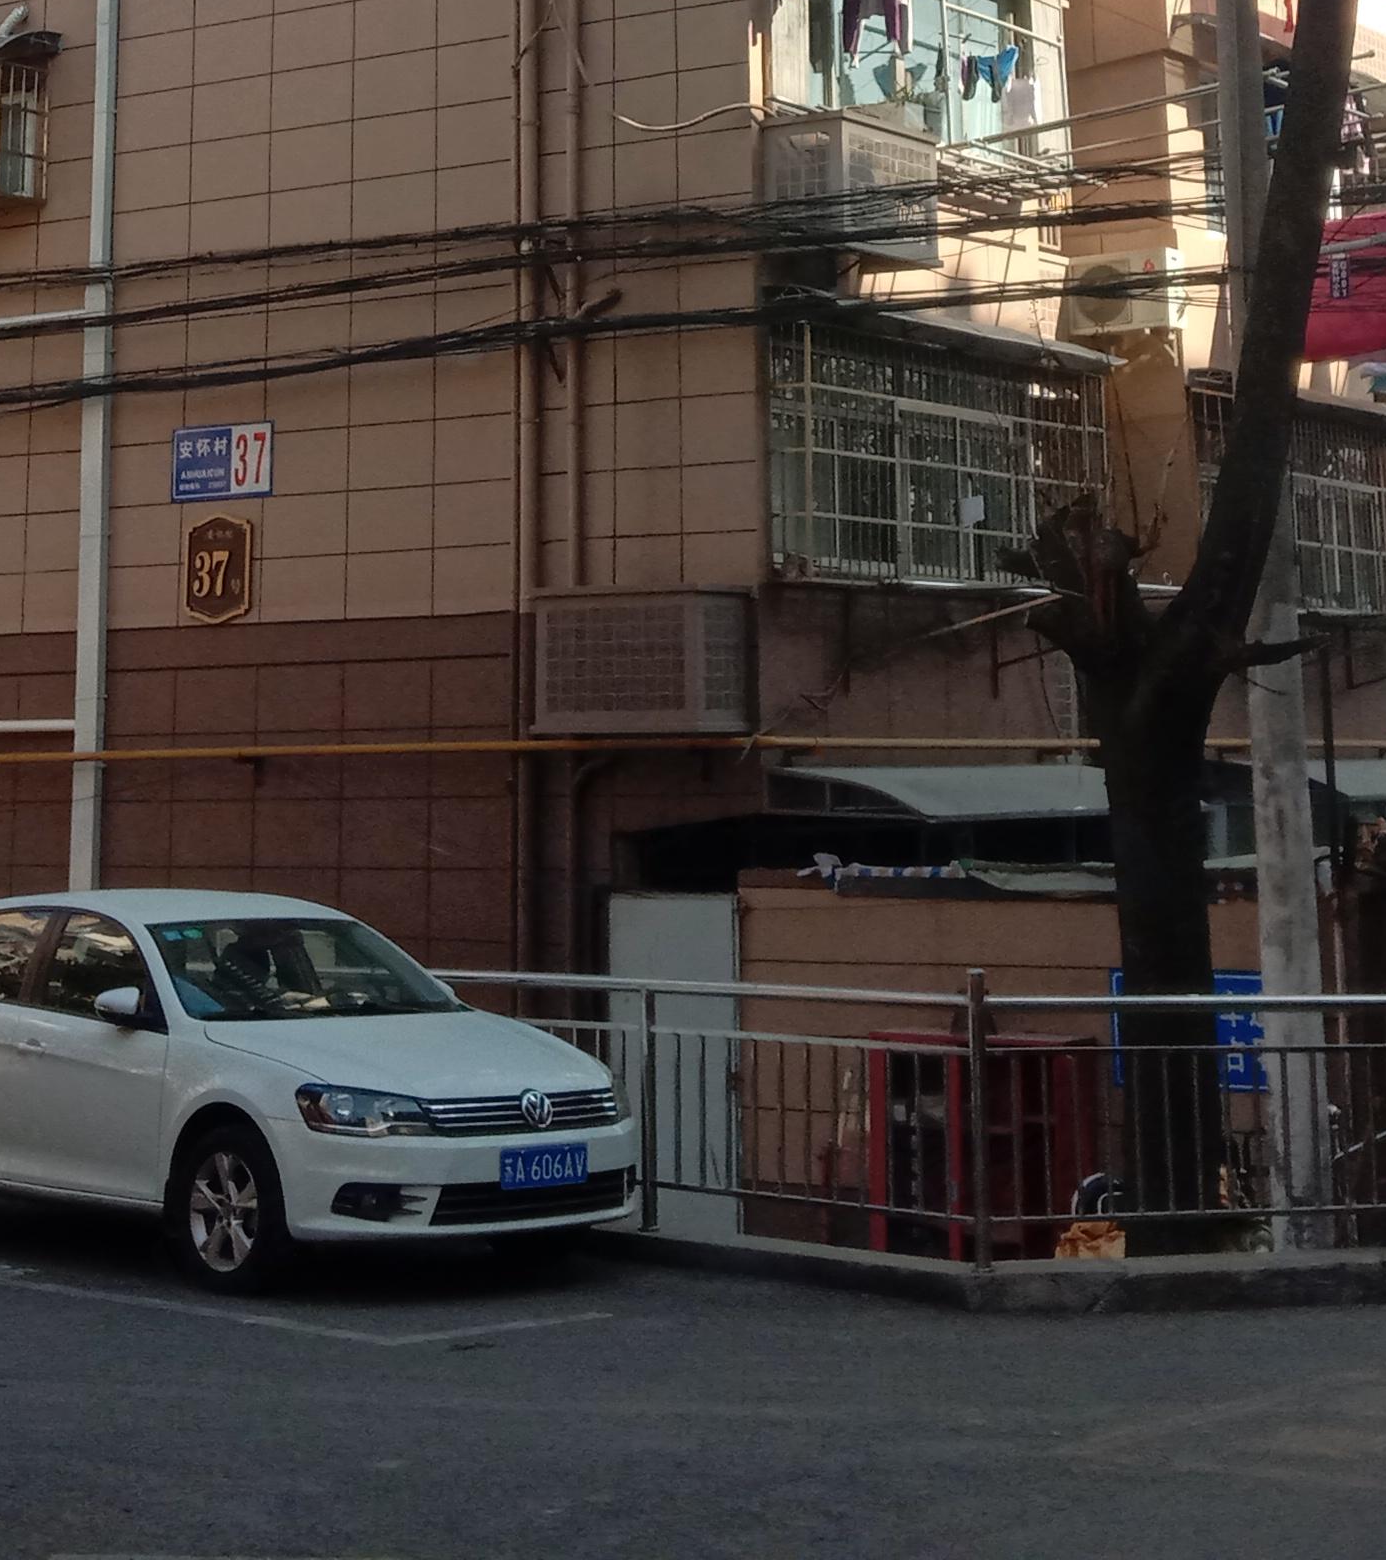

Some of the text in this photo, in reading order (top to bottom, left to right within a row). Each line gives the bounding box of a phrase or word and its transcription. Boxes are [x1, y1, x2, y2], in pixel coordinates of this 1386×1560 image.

[180, 432, 266, 486] 安怀村 37
[193, 551, 229, 597] 37
